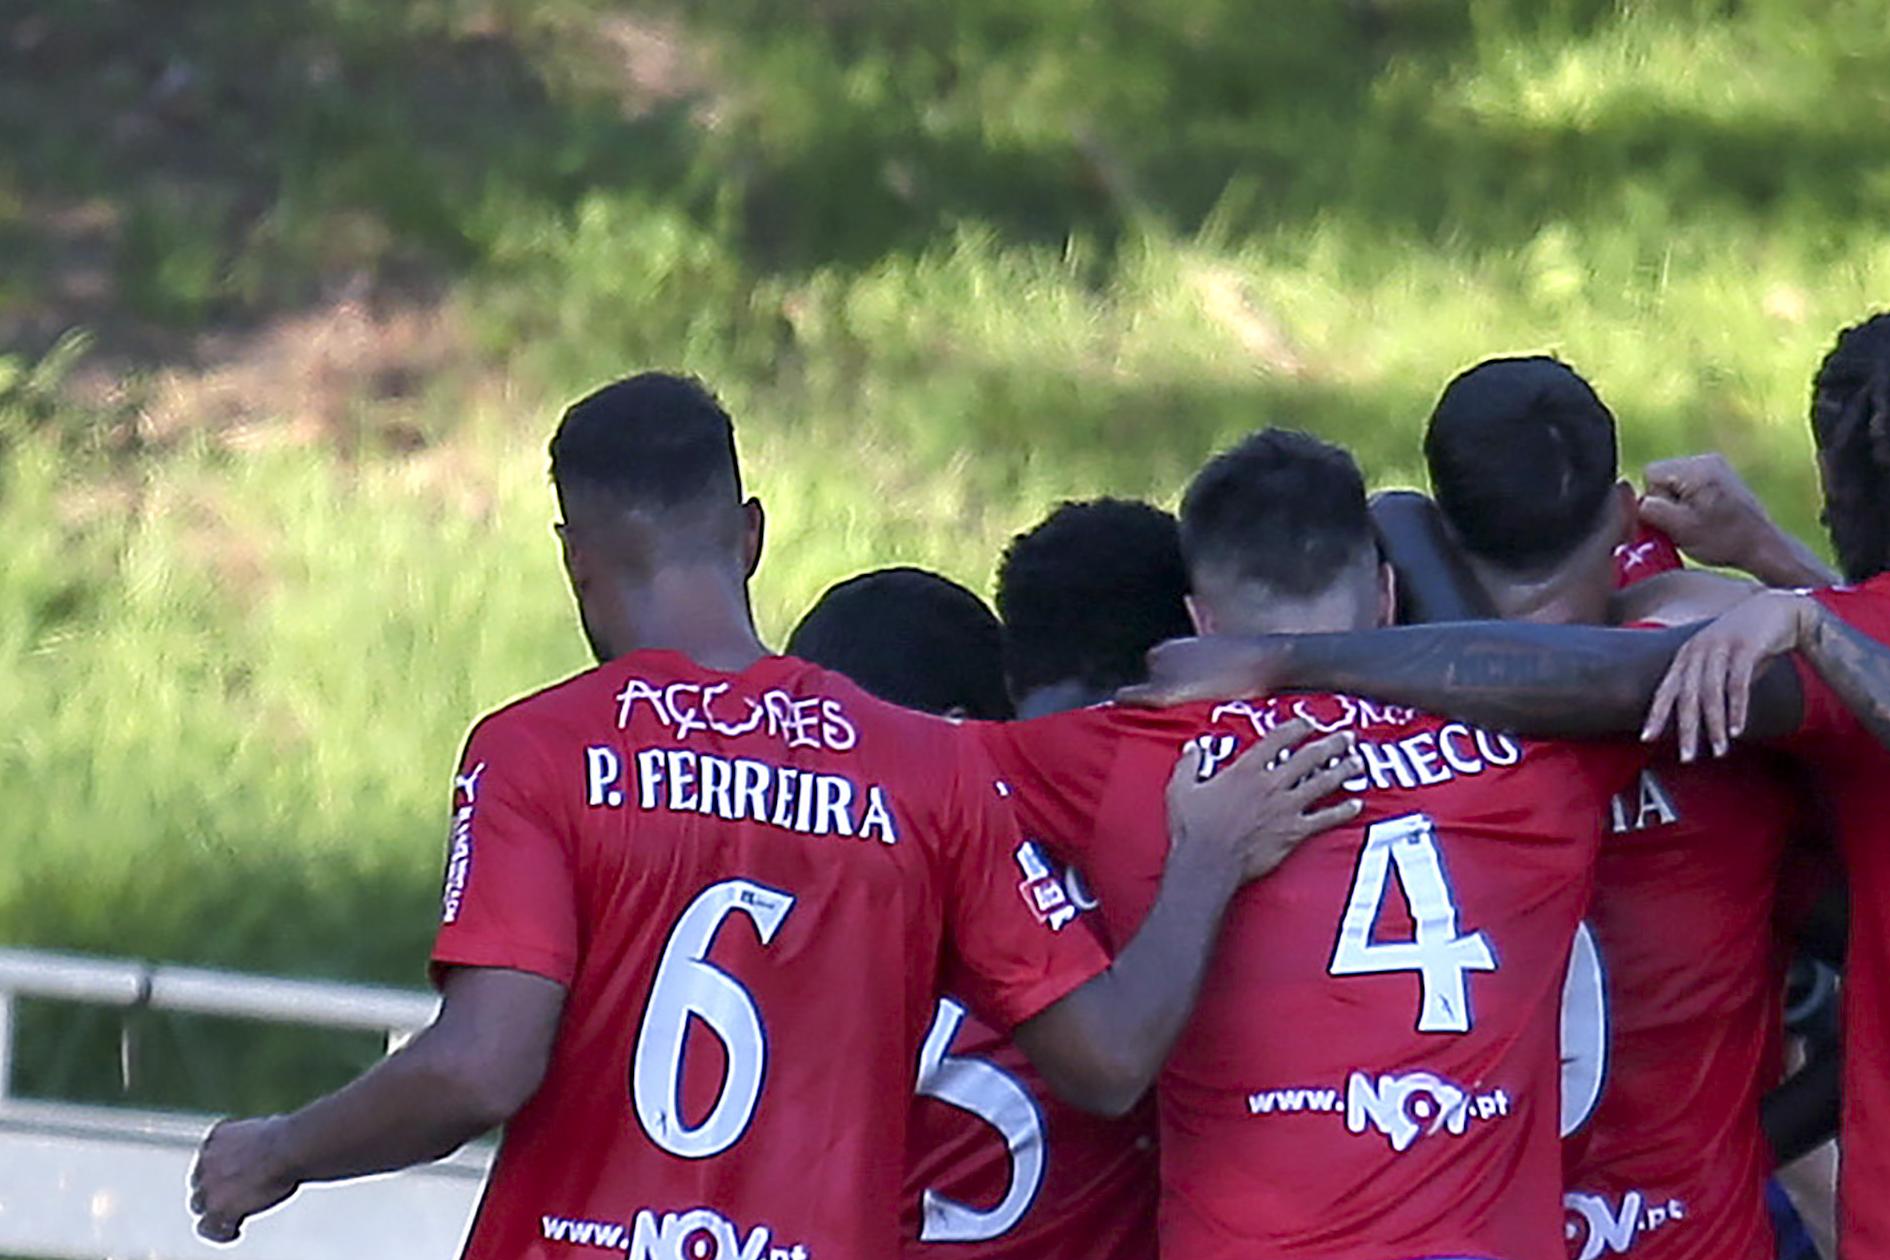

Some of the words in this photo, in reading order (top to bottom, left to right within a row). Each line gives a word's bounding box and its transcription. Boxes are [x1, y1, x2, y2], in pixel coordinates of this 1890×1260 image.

[615, 679, 857, 751] AÇORES
[586, 746, 622, 808] P.
[638, 749, 898, 844] FERREIRA
[1328, 813, 1497, 1032] 4
[632, 878, 796, 1158] 6
